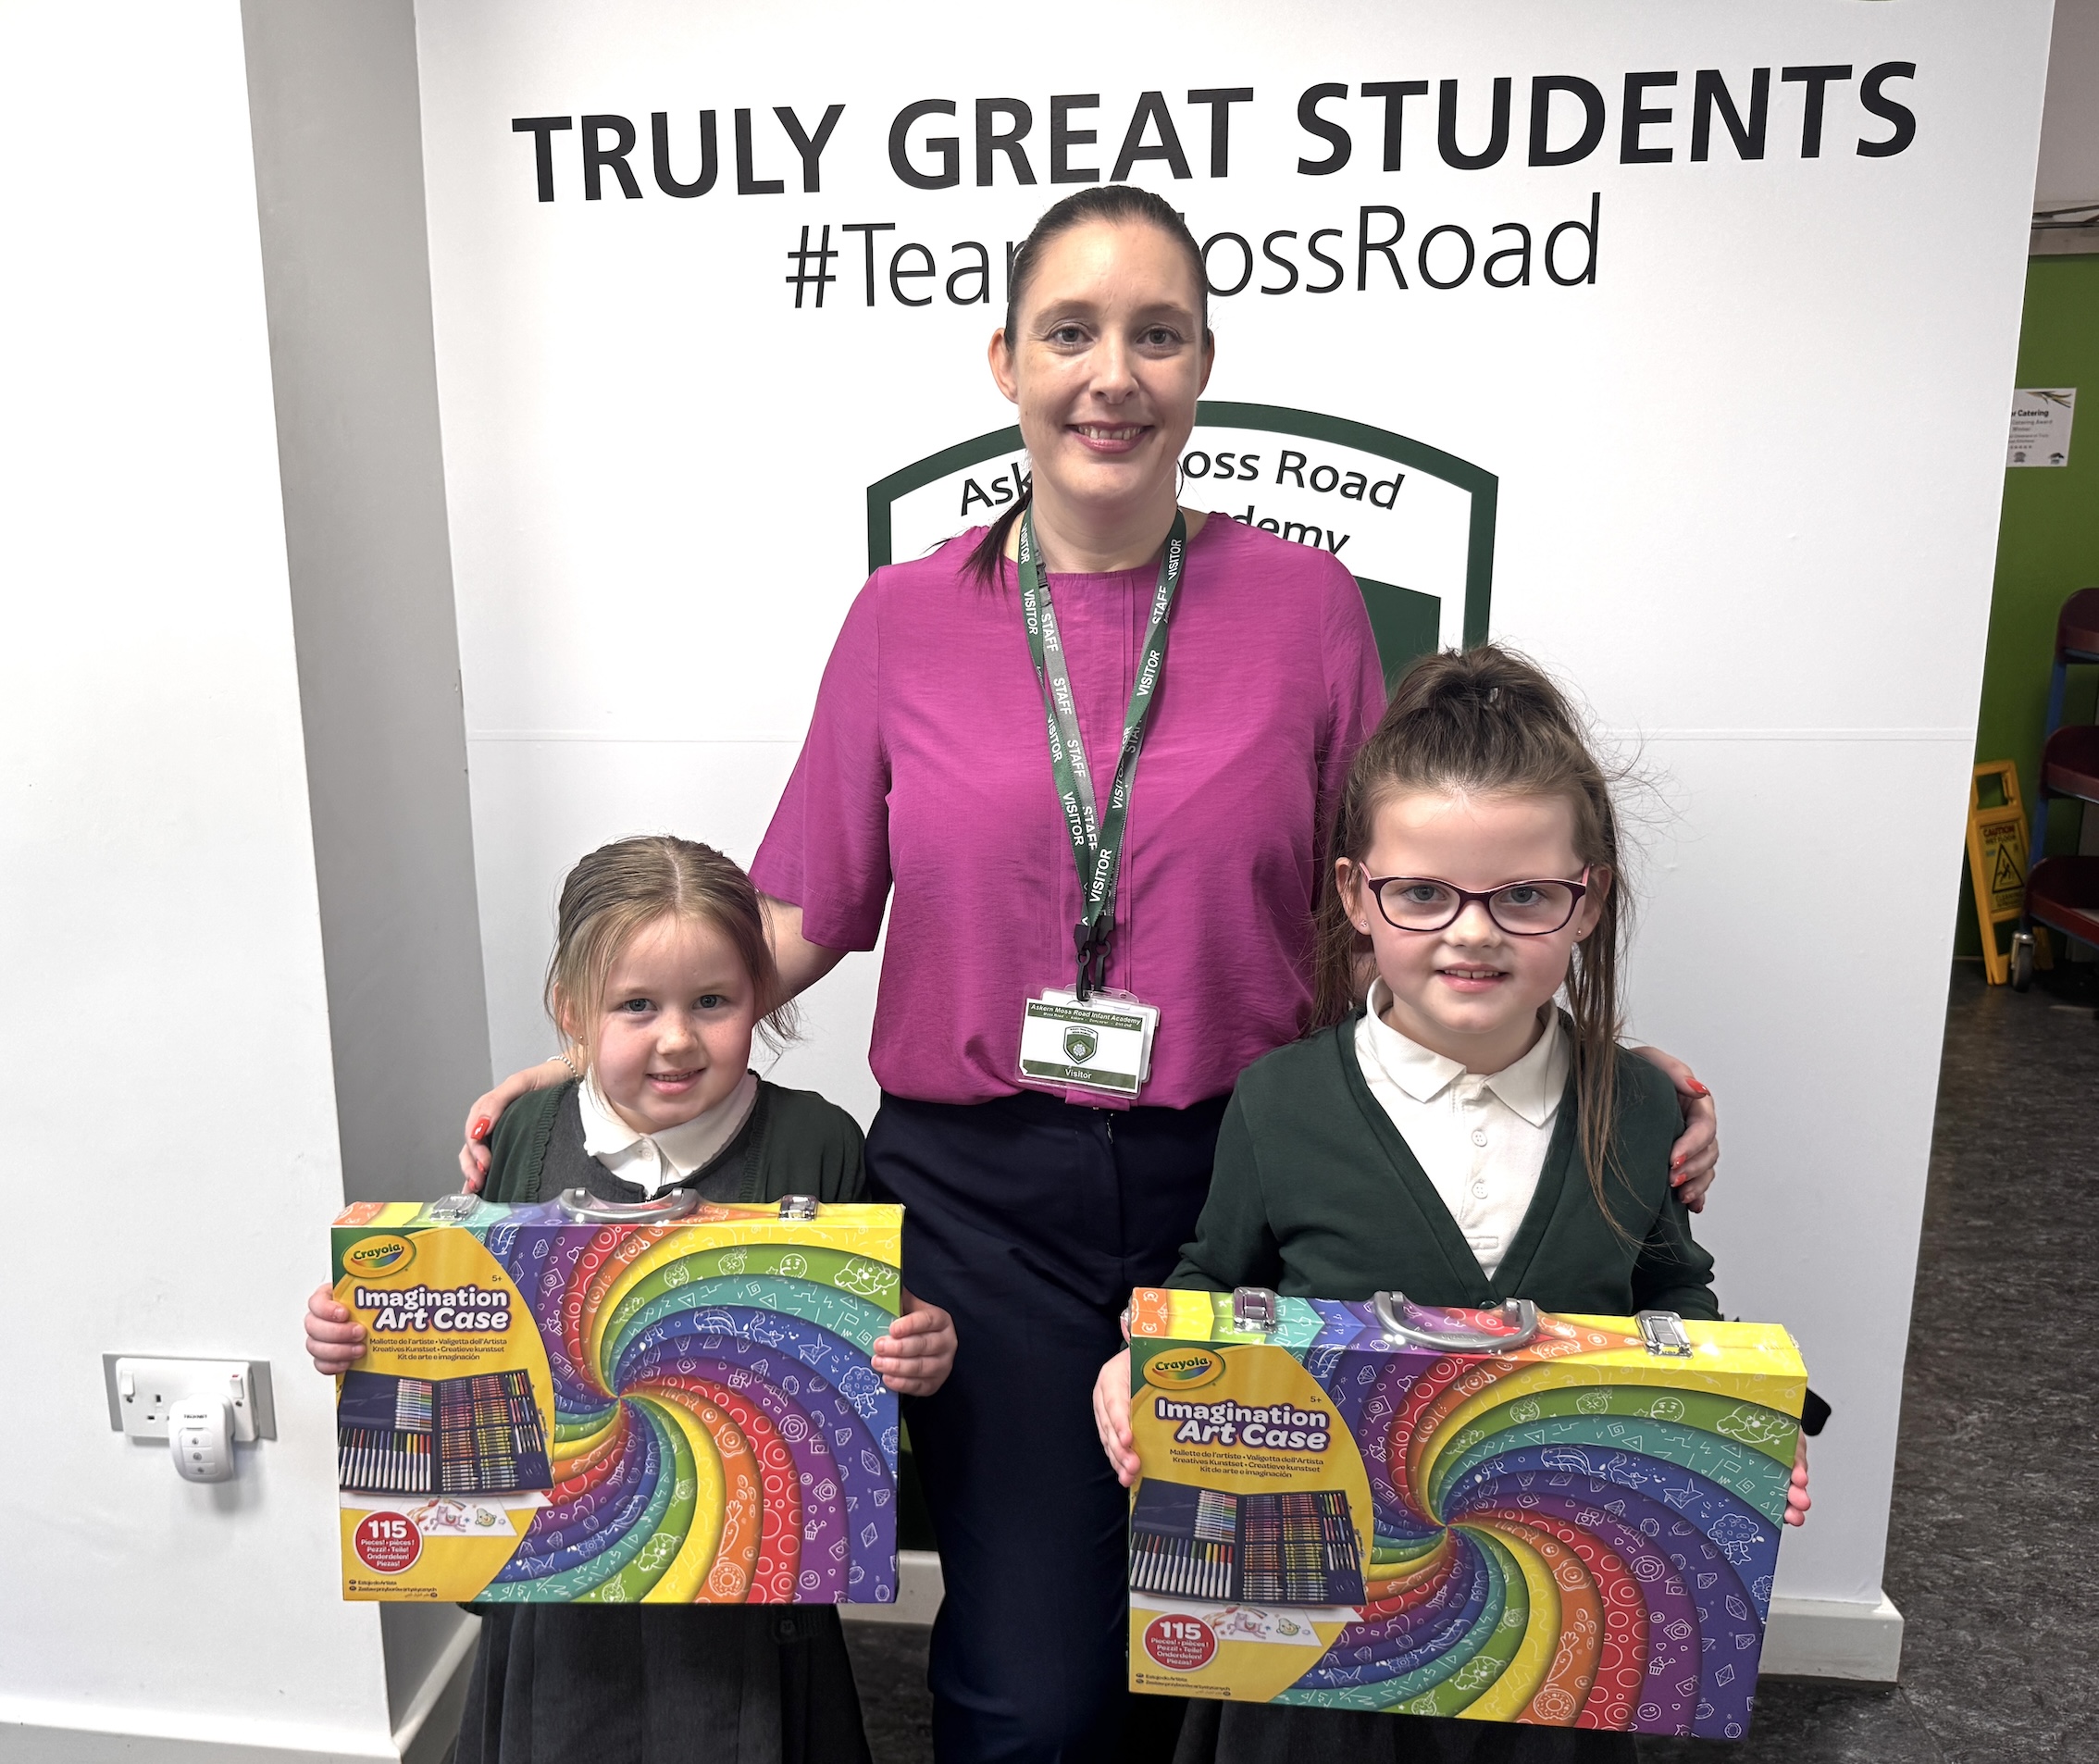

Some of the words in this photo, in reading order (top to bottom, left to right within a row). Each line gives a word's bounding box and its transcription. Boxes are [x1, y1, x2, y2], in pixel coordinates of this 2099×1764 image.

[512, 104, 845, 203] TRULY
[888, 87, 1253, 190] GREAT
[1297, 61, 1917, 176] STUDENTS
[1177, 192, 1601, 297] ossRoad
[2018, 409, 2049, 417] Catering
[1183, 451, 1261, 481] oss
[1275, 450, 1406, 511] Road
[1020, 523, 1031, 565] VISITOR
[1168, 539, 1182, 580] VISITOR
[1024, 589, 1038, 635] VISITOR
[1152, 585, 1167, 625] STAFF
[1041, 613, 1059, 652] STAFF
[1136, 649, 1160, 696] VISITOR
[1053, 677, 1072, 715] STAFF
[1048, 714, 1062, 763] VISITOR
[1067, 739, 1086, 777] STAFF
[1063, 791, 1085, 846] VISITOR
[1084, 806, 1098, 851] STAFF
[1089, 849, 1112, 902] VISITOR
[1031, 1004, 1053, 1012] Askern
[1055, 1007, 1073, 1015] Moss
[1074, 1009, 1090, 1018] Road
[1091, 1012, 1111, 1020] Infant
[1111, 1014, 1141, 1025] Academy
[1064, 1068, 1091, 1079] Visitor
[354, 1244, 401, 1260] Crayola
[357, 1286, 508, 1311] Imagination
[376, 1308, 428, 1330] Art
[434, 1308, 509, 1330] Case
[1155, 1357, 1210, 1372] Crayola
[1158, 1399, 1326, 1428] Imagination
[1178, 1420, 1236, 1444] Art
[1242, 1423, 1327, 1449] Case
[1170, 1448, 1200, 1458] Mallette
[1247, 1454, 1280, 1462] Valigetta
[1282, 1457, 1323, 1465] dell'Artista
[1286, 1464, 1321, 1472] kunstset
[368, 1520, 408, 1539] 115
[1160, 1621, 1201, 1640] 115
[1157, 1651, 1202, 1659] Onderdelen!
